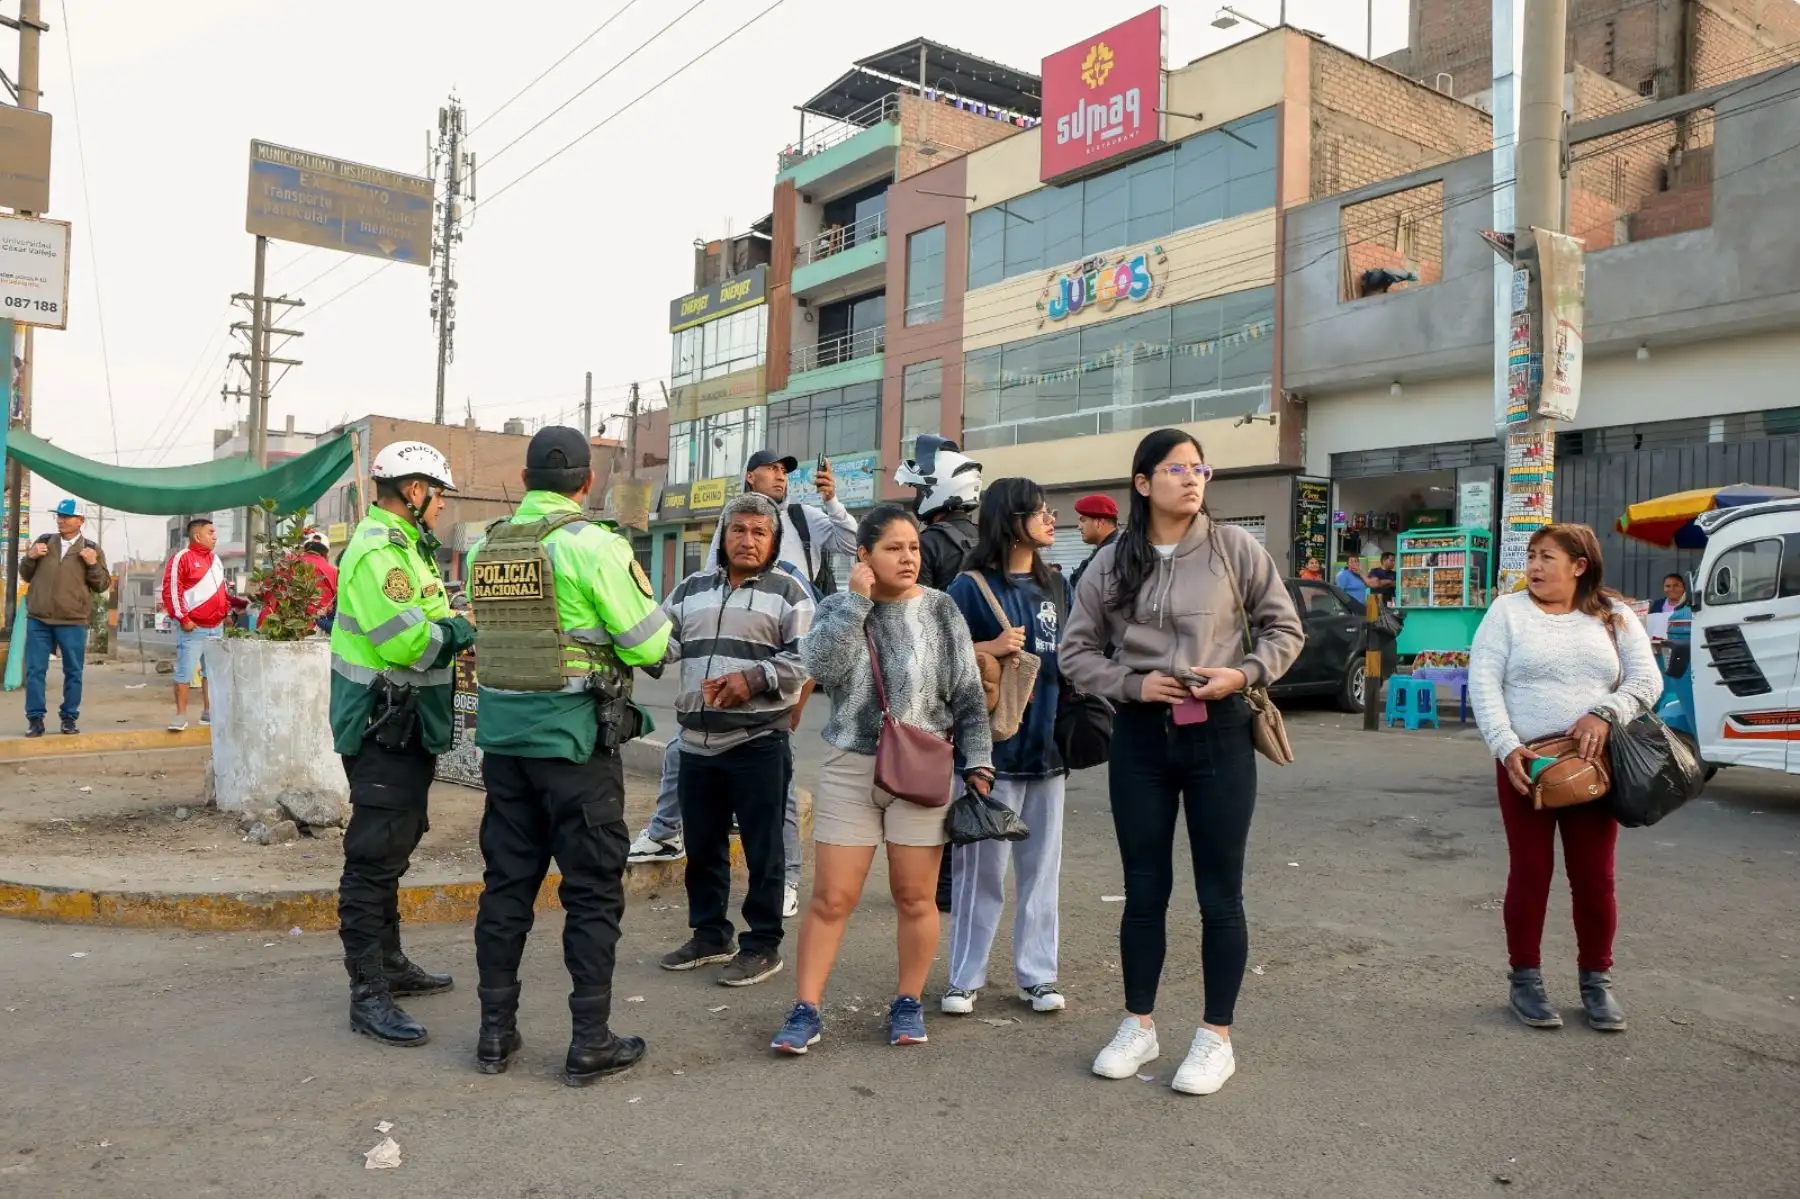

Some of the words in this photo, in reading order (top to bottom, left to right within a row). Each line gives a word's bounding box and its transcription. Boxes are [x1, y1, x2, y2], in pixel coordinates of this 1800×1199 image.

[258, 145, 336, 173] MUNICIPALIDAD
[1048, 252, 1152, 321] JUEGOS
[5, 296, 31, 309] 087
[34, 300, 58, 313] 188
[693, 494, 701, 504] EL
[474, 583, 538, 597] NACIONAL
